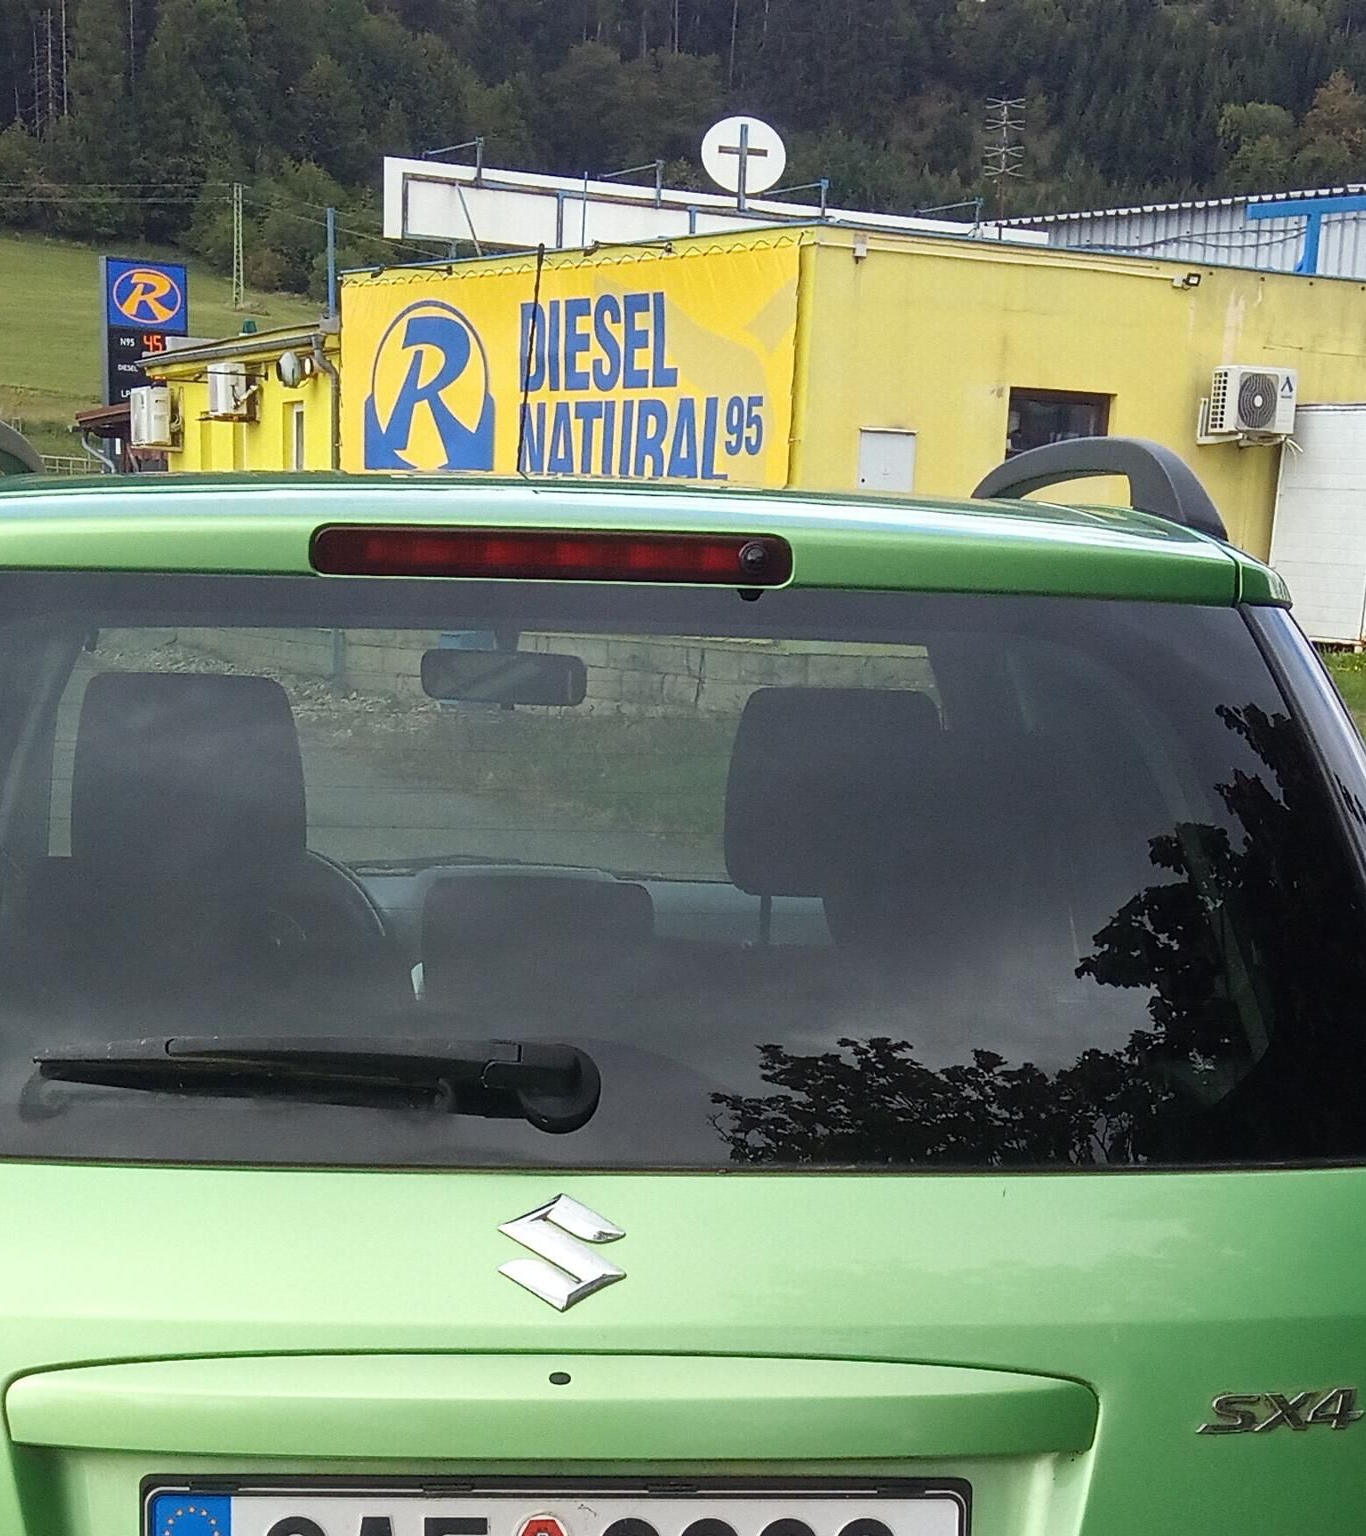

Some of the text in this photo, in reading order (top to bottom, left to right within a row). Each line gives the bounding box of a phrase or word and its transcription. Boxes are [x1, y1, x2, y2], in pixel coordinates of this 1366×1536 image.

[519, 291, 679, 393] DIESEL
[117, 364, 139, 373] DIESEL
[120, 389, 132, 398] LP
[519, 395, 765, 481] NATURAL 95
[1195, 1387, 1365, 1434] SX4
